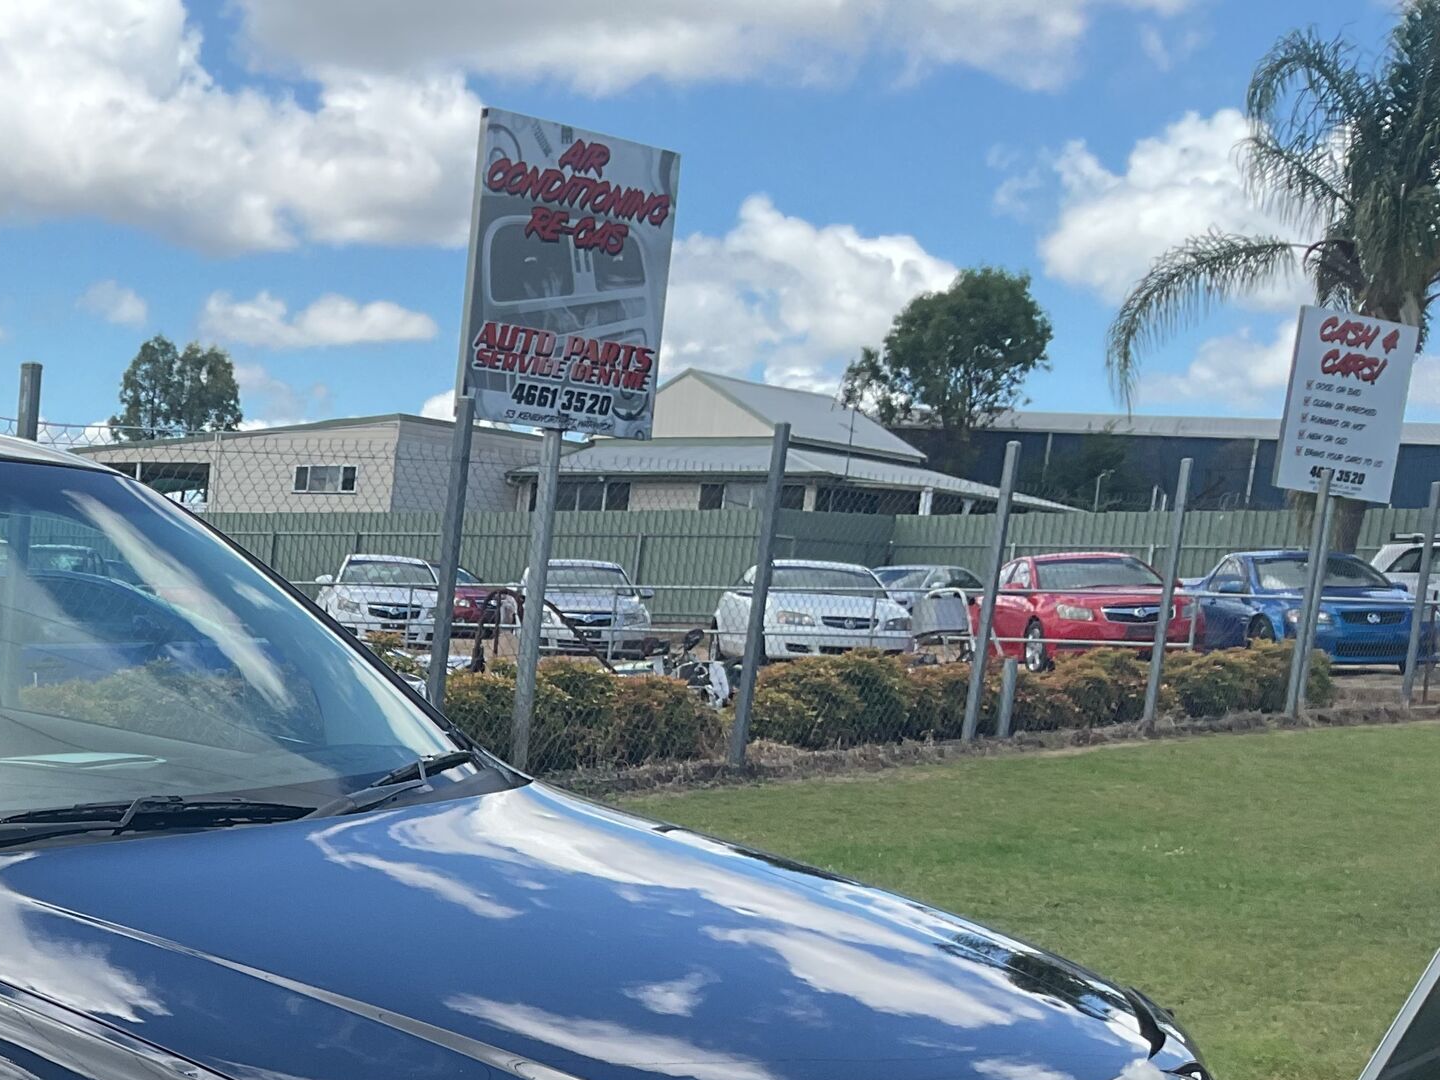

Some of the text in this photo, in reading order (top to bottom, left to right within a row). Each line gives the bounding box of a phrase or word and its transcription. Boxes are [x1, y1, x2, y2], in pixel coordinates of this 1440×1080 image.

[558, 139, 610, 179] AIR
[488, 157, 671, 229] CONDITIONING
[525, 206, 629, 256] RE-GAS
[474, 322, 655, 373] AUTO PARTS
[1320, 316, 1399, 354] CASH 4
[473, 348, 651, 392] SERVICE CENTRE
[1321, 349, 1388, 385] CARS!
[511, 383, 612, 416] 4661 3520
[1336, 469, 1366, 485] 3520
